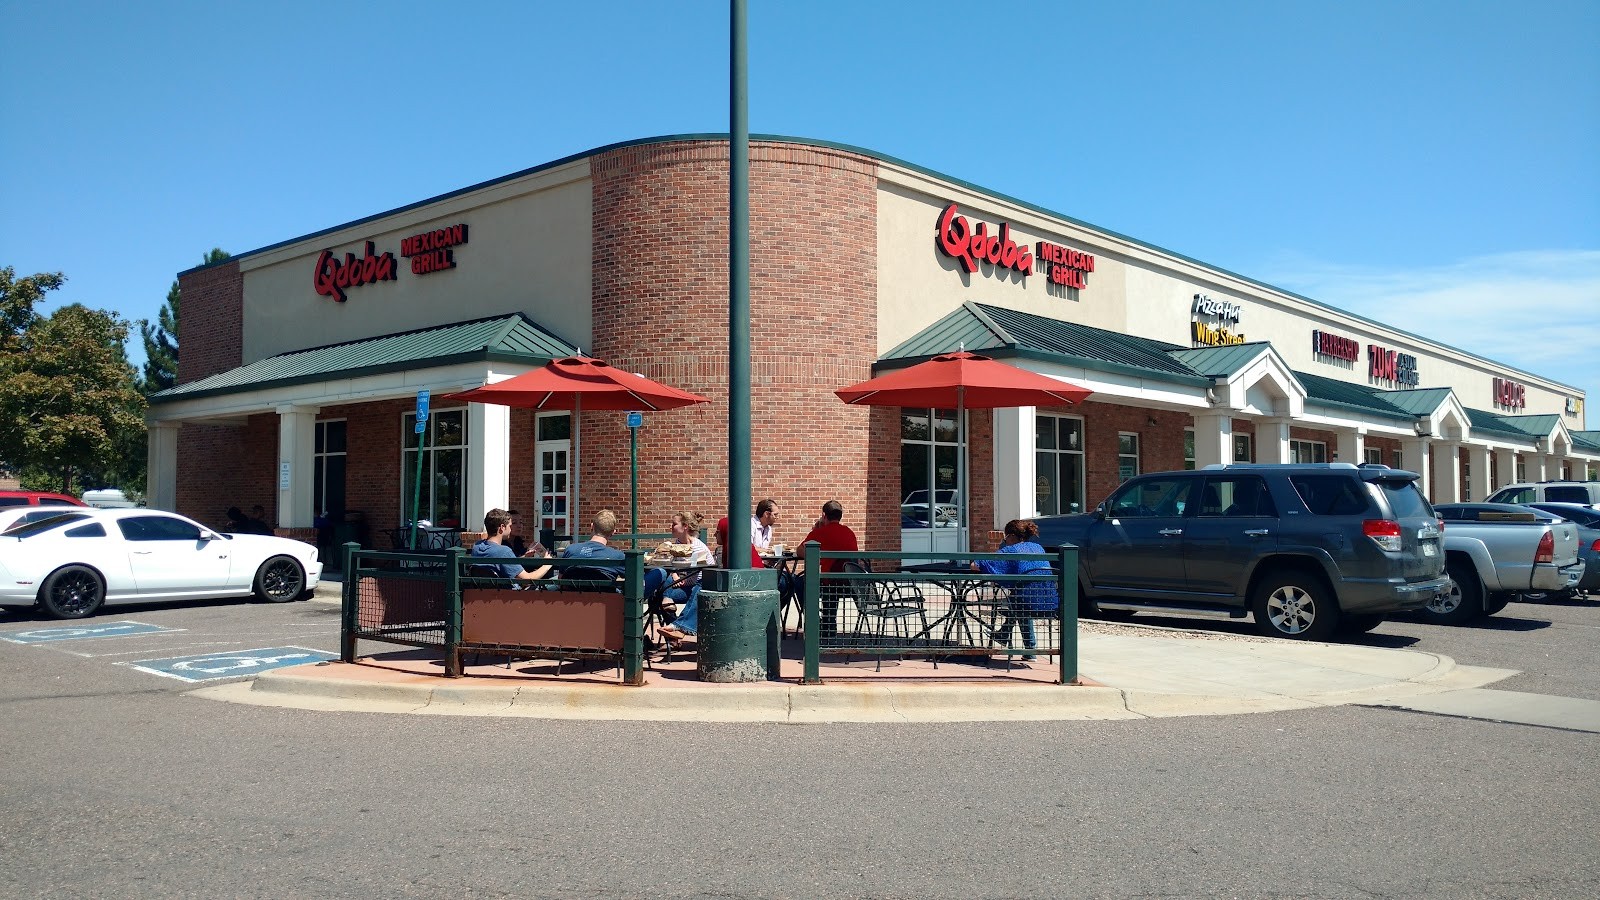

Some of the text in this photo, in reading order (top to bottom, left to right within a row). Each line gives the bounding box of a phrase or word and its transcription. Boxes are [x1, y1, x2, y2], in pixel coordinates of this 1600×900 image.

[402, 224, 467, 257] MEXICAN
[936, 204, 1033, 277] Qdoba
[314, 241, 396, 302] Qdoba
[411, 250, 455, 275] GRILL
[1037, 242, 1094, 272] MEXICAN
[1048, 266, 1086, 290] GRILL
[1194, 293, 1243, 323] Pizza Hut
[1370, 345, 1398, 381] ZUME
